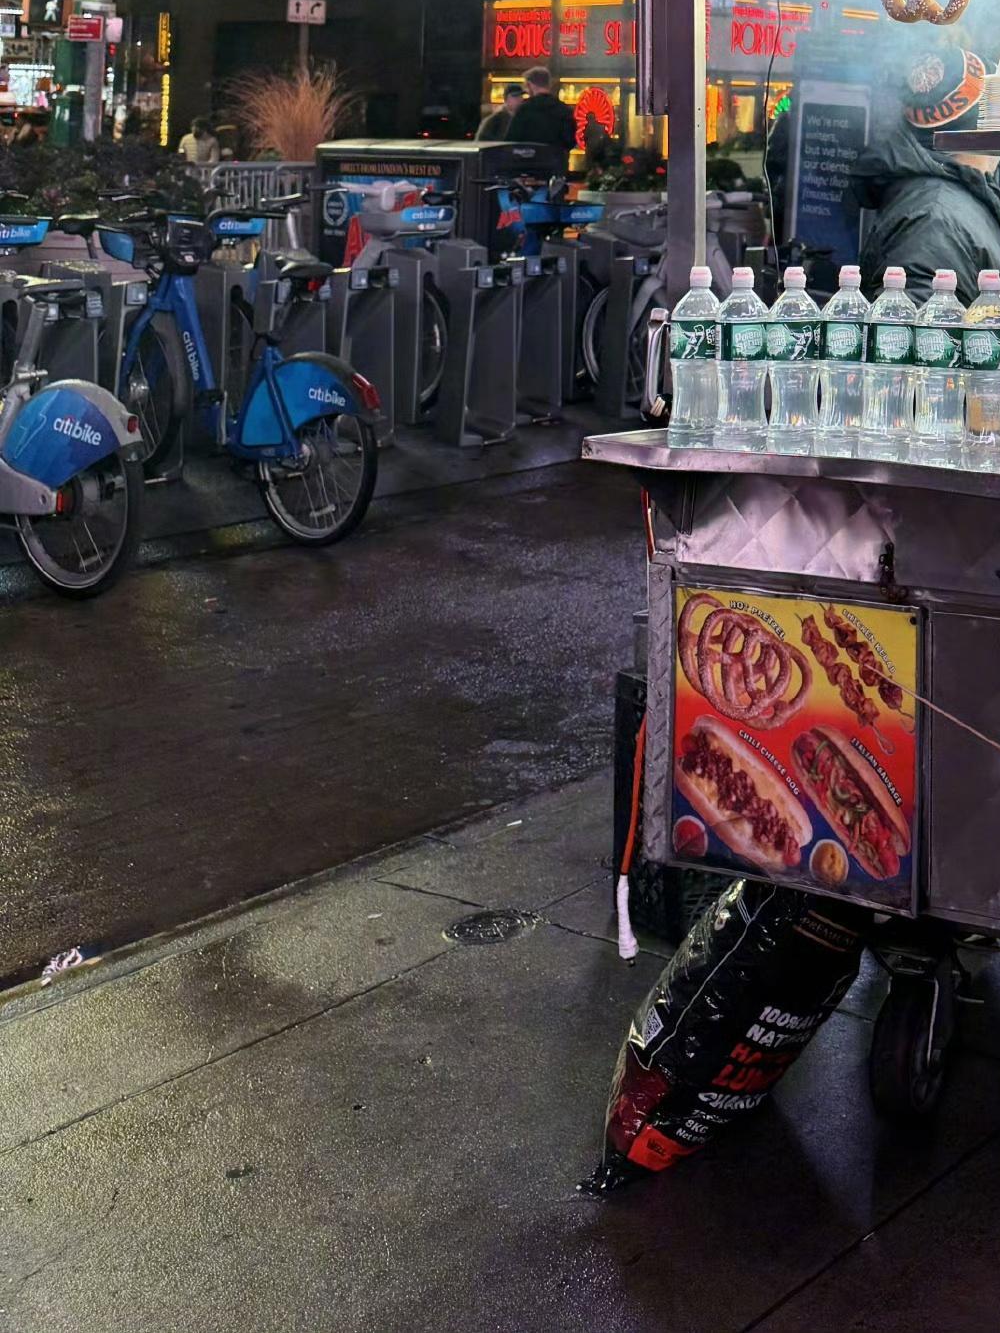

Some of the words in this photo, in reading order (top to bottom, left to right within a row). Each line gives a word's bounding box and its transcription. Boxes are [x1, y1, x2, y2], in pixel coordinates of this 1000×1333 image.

[729, 600, 749, 611] HOT
[750, 607, 787, 642] PRETZEL
[842, 608, 876, 642] CHICKEN
[738, 729, 760, 750] CHILI
[760, 746, 787, 775] CHEESE
[785, 775, 800, 796] DOG
[850, 737, 878, 768] ITALIAN
[876, 766, 904, 807] SAUSAGE
